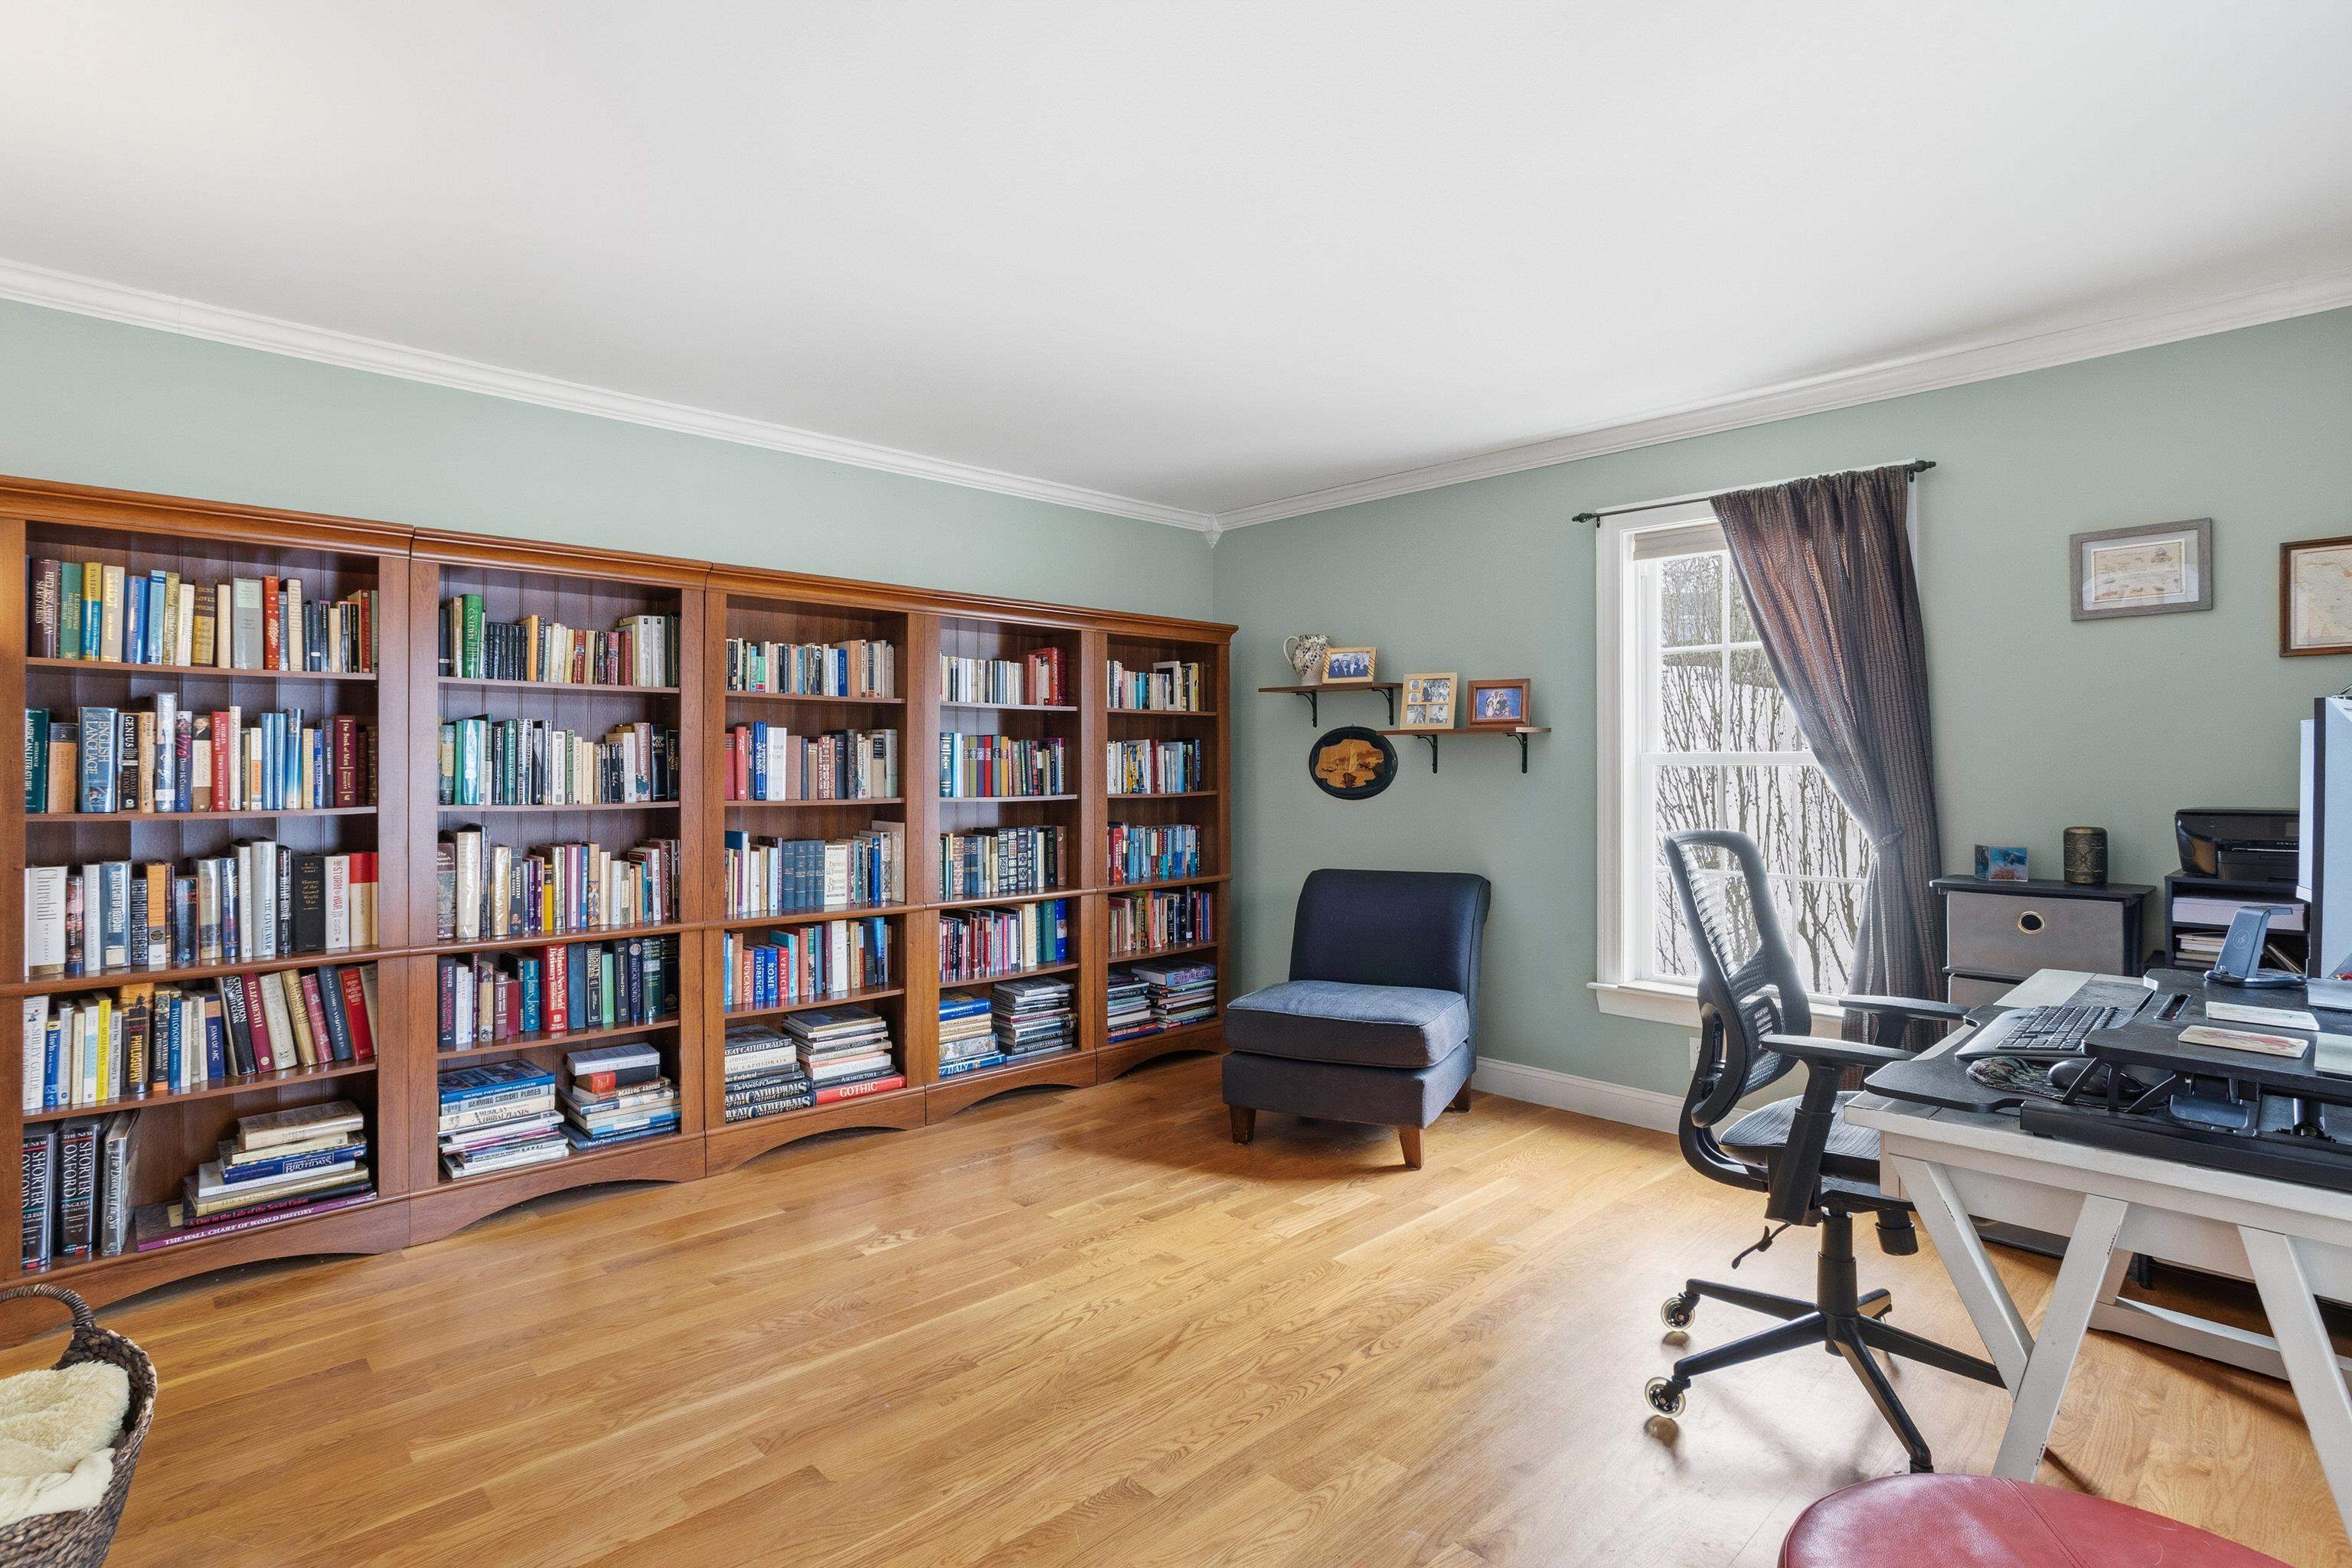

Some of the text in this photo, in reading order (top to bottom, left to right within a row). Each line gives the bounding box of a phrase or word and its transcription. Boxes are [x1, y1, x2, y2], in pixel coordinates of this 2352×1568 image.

[44, 606, 54, 635] AMERICAN
[25, 719, 34, 750] AMERICAN
[85, 720, 98, 775] LANGUAGE
[98, 721, 110, 763] ENGLISH
[125, 716, 135, 748] GENIUS
[175, 733, 188, 756] 1776
[36, 869, 58, 921] Churchill
[332, 866, 344, 890] STORM
[113, 908, 122, 933] FREEDOM
[548, 949, 557, 981] Dictionary
[557, 947, 566, 978] Webster's
[743, 960, 751, 997] TUSCANY
[234, 977, 247, 1022] CIVILISATION
[247, 982, 261, 1024] ELIZABETH
[557, 990, 566, 1010] World
[171, 1008, 180, 1050] PHILOSOPHY
[29, 1028, 42, 1090] SIBLEY GUIDE
[129, 1035, 142, 1083] PHILOSOPHY
[741, 1040, 784, 1054] CATHEDRALS
[746, 1081, 808, 1104] CATHEDRALS
[839, 1081, 878, 1097] GOTHIC
[748, 1096, 811, 1119] CATHEDRALS
[32, 1152, 47, 1207] SHORTER
[63, 1144, 78, 1198] OXFORD
[78, 1142, 93, 1196] SHORTER
[165, 1207, 315, 1246] THE WALL CHART OF WORLD HISTORY
